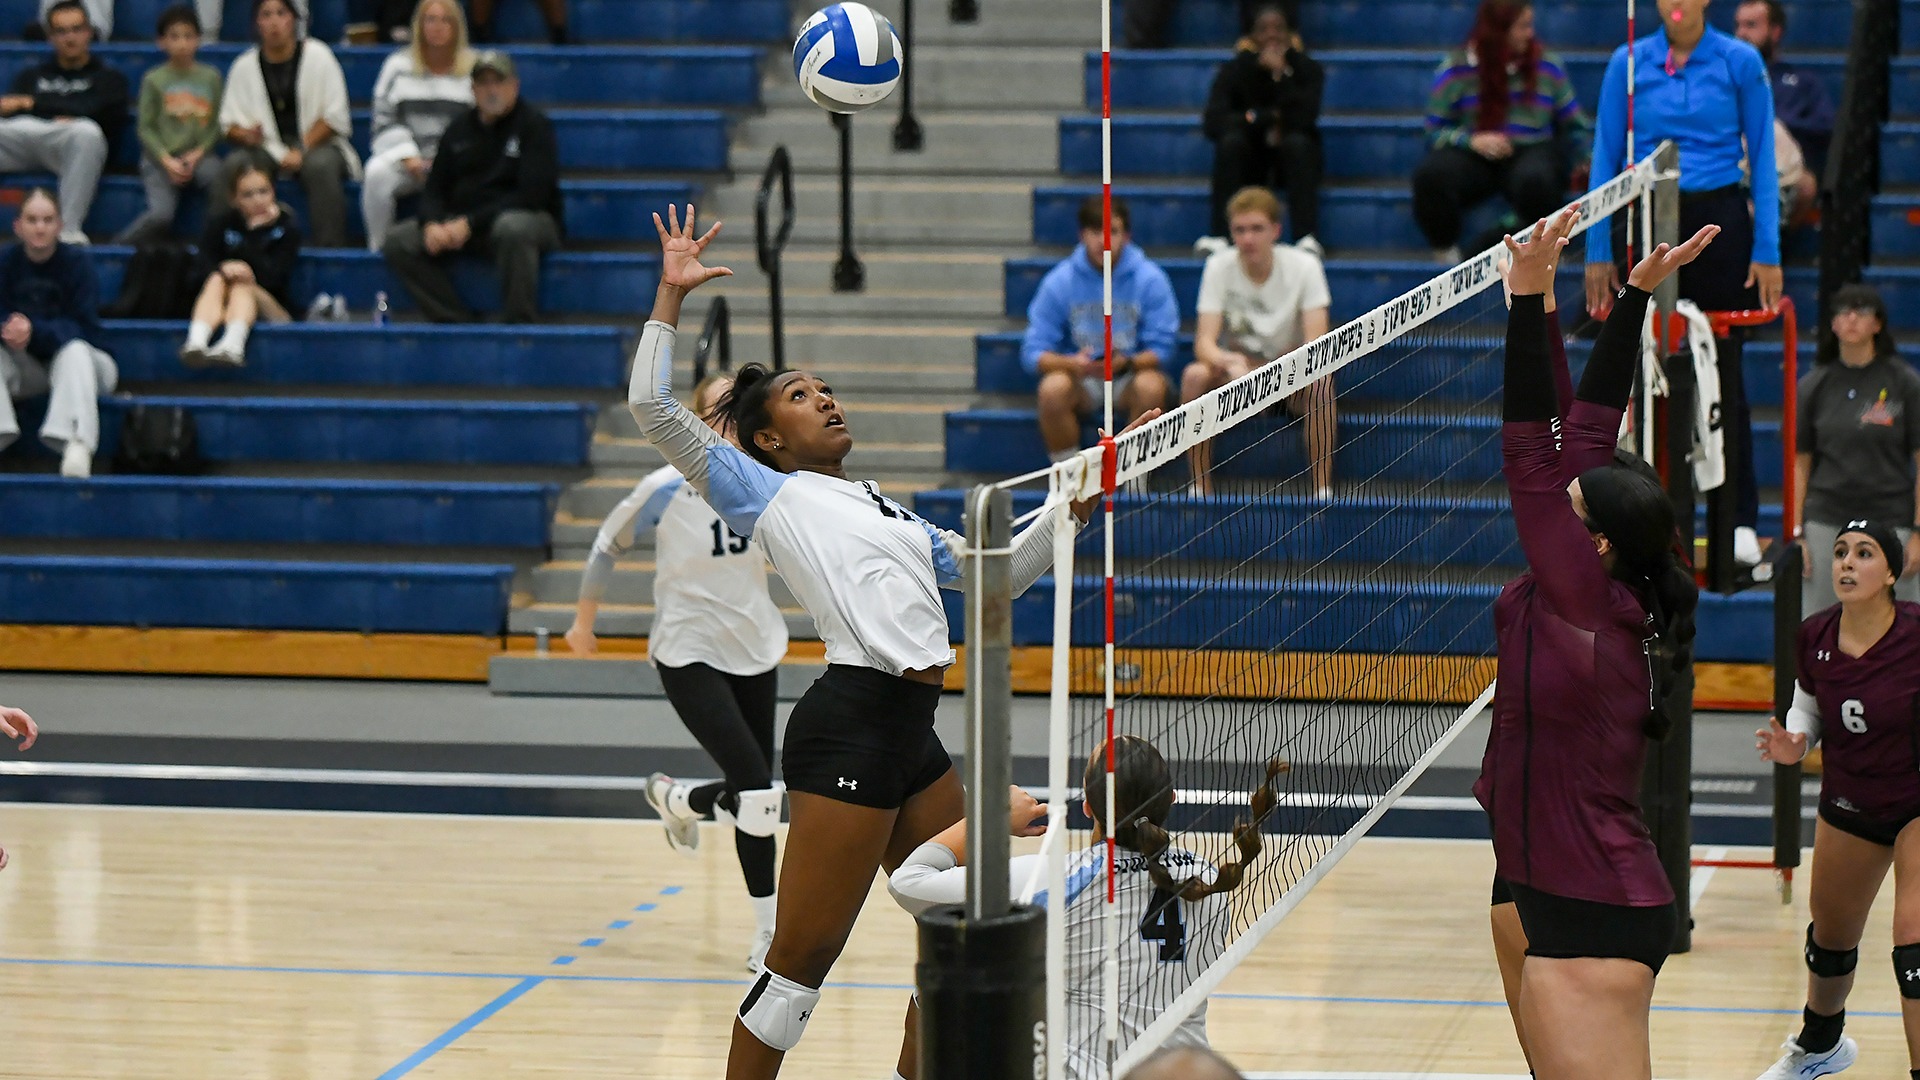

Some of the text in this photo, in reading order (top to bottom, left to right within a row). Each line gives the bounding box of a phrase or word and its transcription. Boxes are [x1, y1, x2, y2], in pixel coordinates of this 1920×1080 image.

[710, 518, 749, 557] 15
[1841, 698, 1868, 734] 6
[1138, 887, 1187, 964] 4
